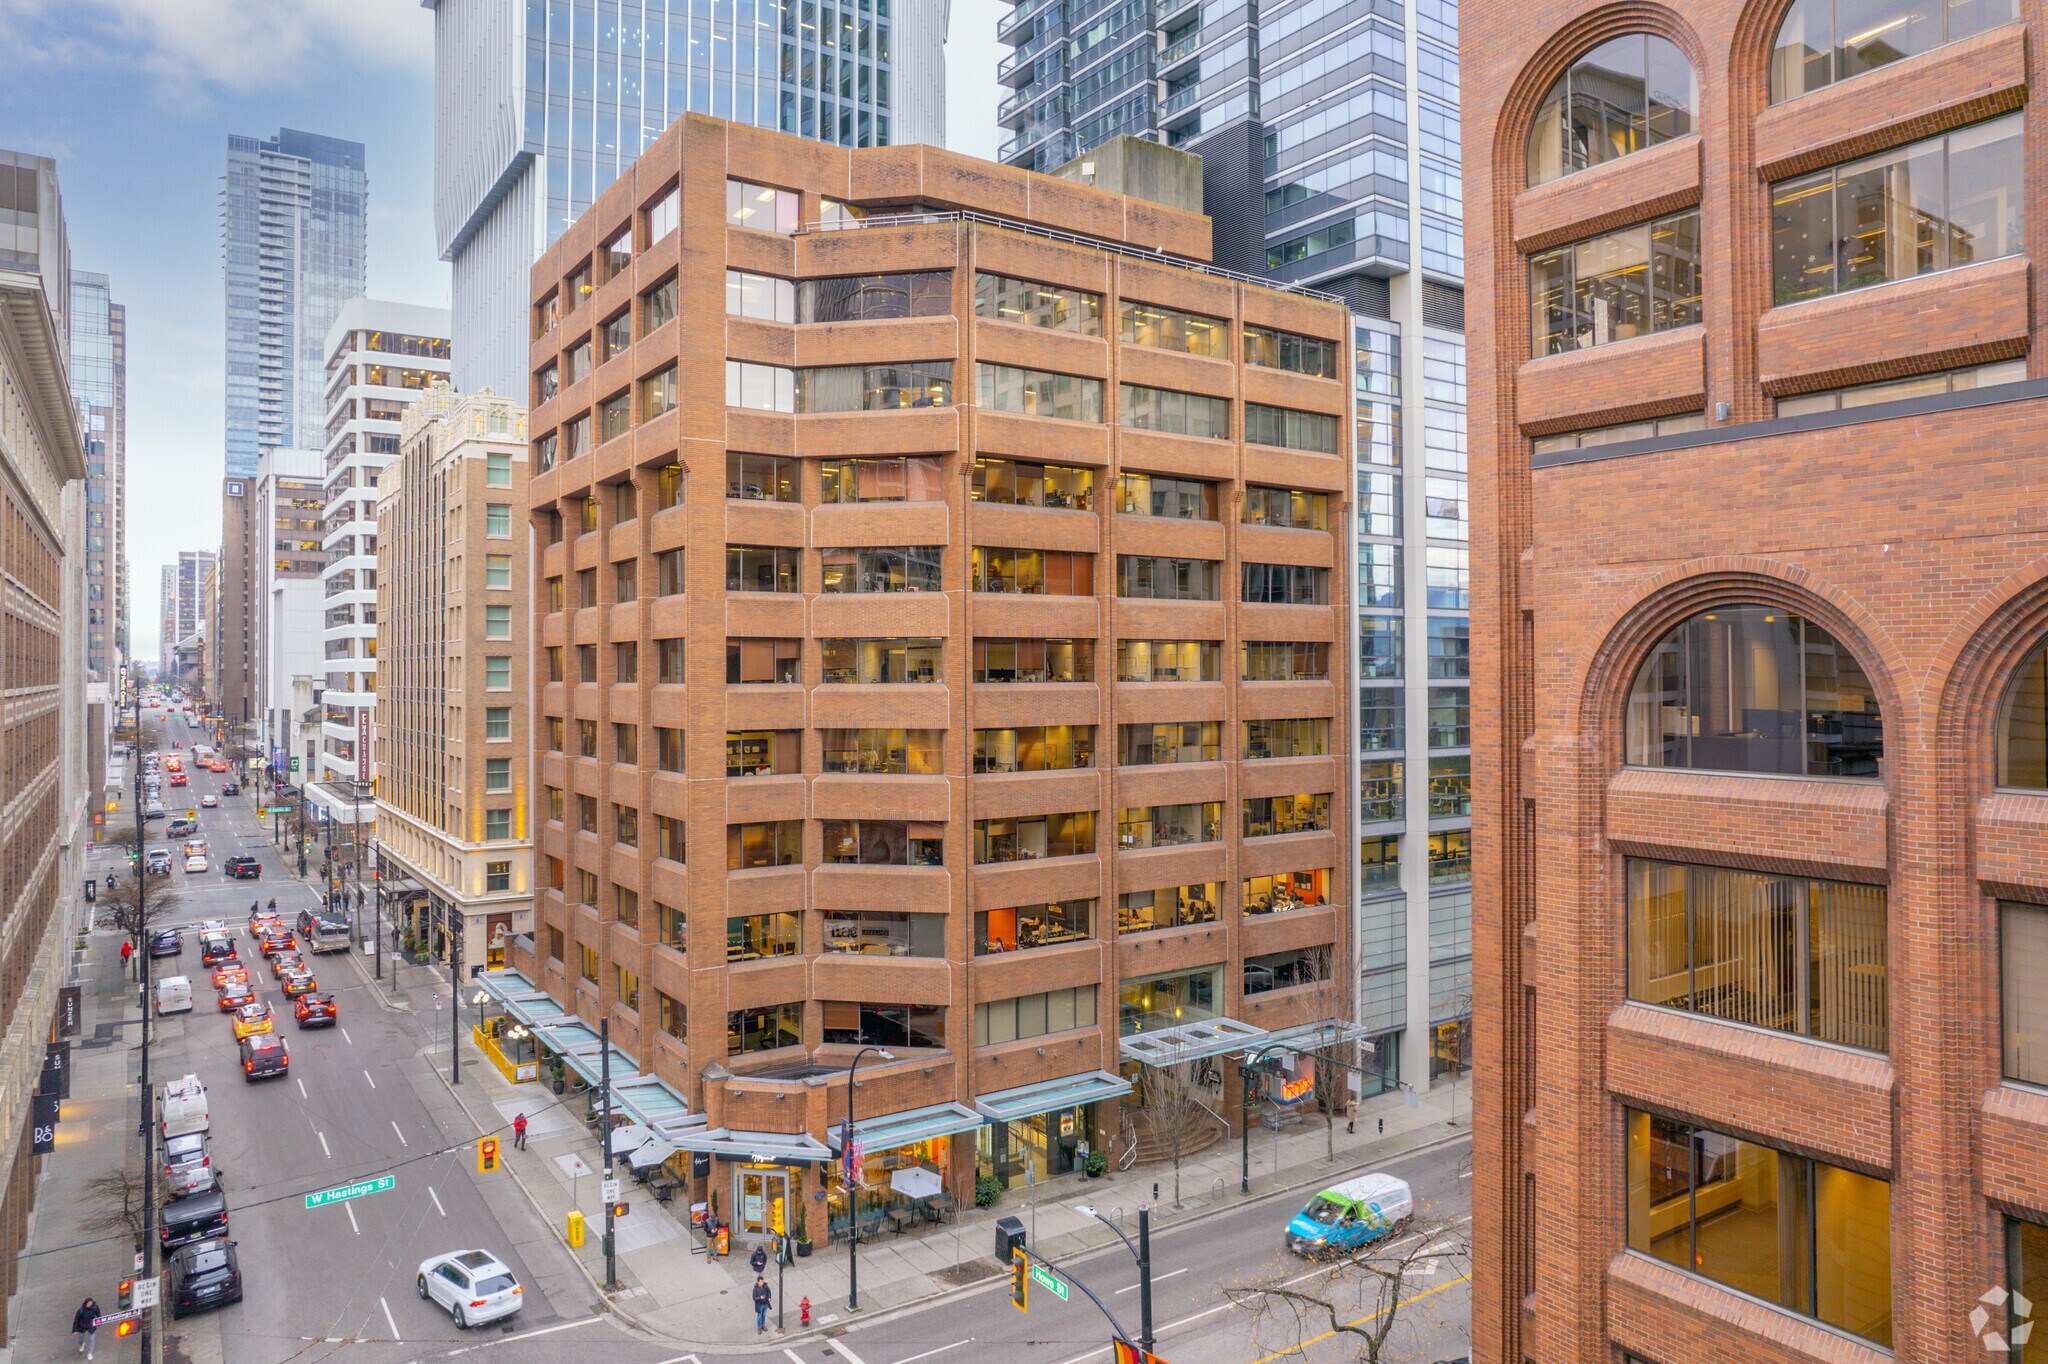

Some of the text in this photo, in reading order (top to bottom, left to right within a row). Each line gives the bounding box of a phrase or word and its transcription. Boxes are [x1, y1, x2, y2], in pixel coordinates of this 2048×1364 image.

[310, 1178, 388, 1204] W Hastings St
[137, 1282, 156, 1290] BEGIN
[1034, 1270, 1064, 1296] Howe St
